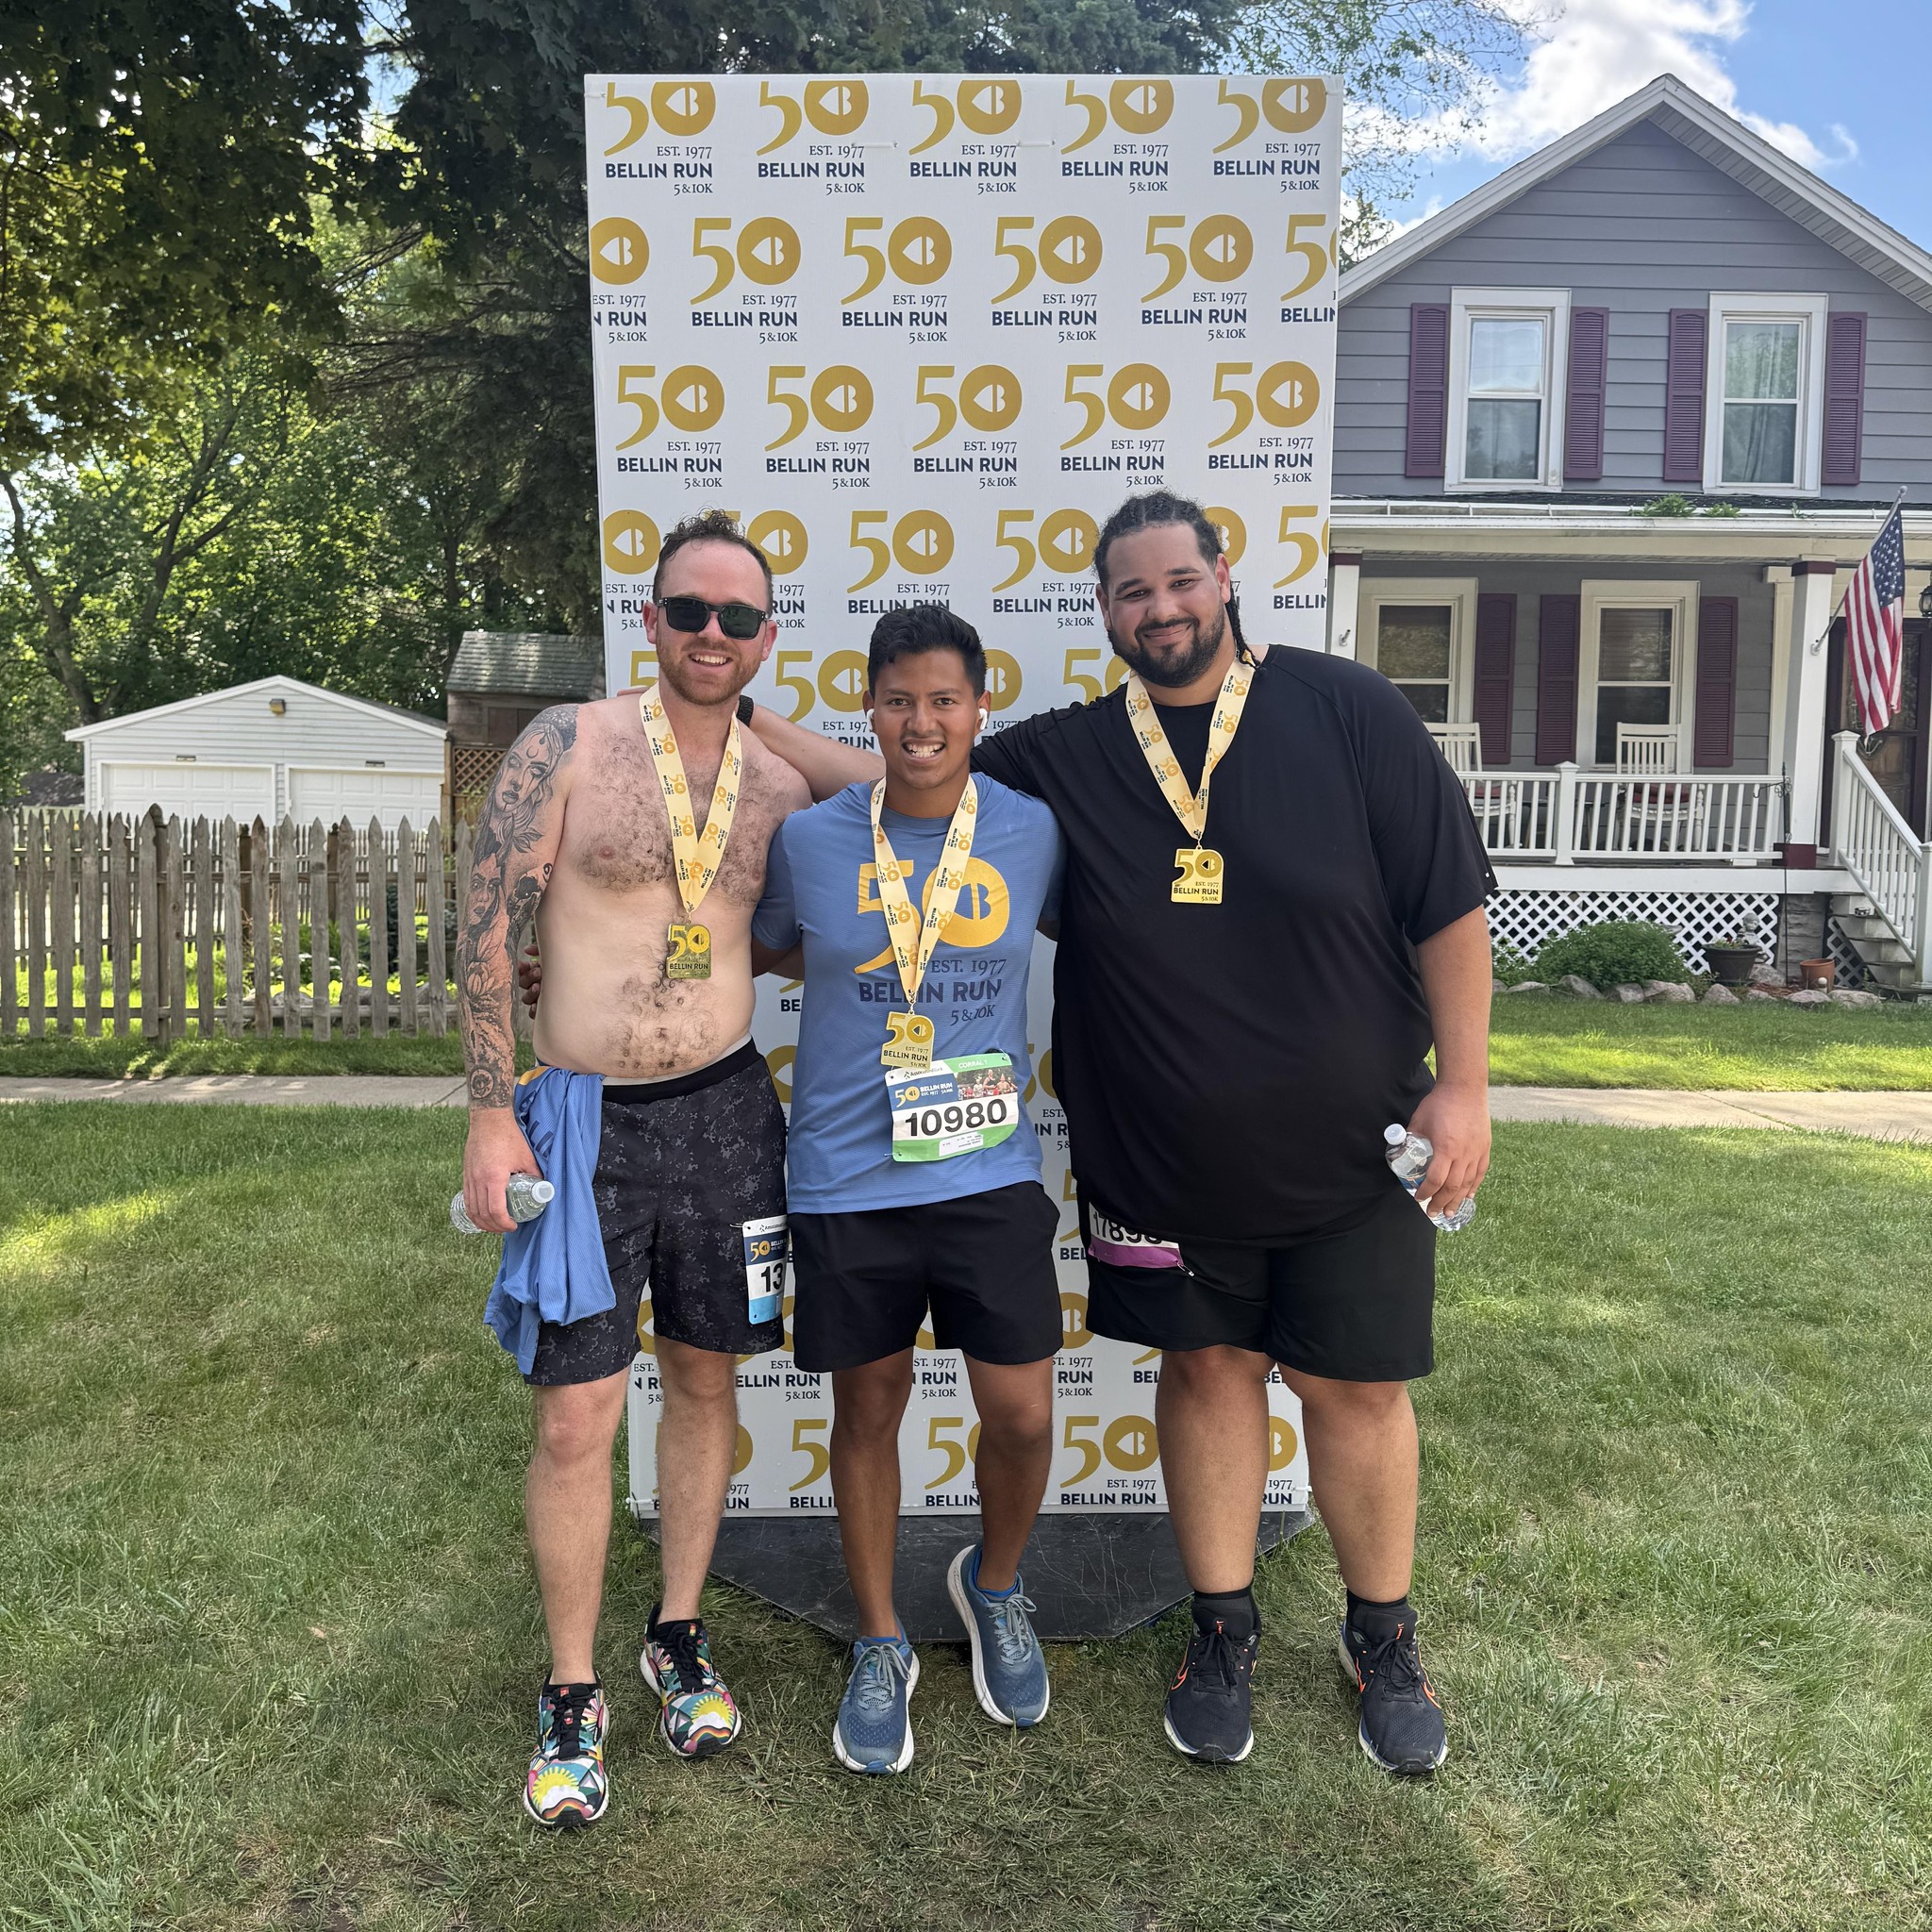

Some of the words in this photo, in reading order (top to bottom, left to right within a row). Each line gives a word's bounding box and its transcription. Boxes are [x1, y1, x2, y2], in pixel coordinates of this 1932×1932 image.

[604, 81, 716, 157] 50
[756, 81, 868, 157] 50
[908, 80, 1021, 156] 50
[1060, 79, 1173, 155] 50
[1212, 78, 1324, 154] 50
[658, 146, 680, 156] EST.
[686, 147, 712, 158] 1977
[809, 145, 833, 156] EST.
[839, 145, 864, 158] 1977
[961, 145, 985, 155] EST.
[991, 145, 1017, 158] 1977
[1114, 144, 1137, 154] EST.
[1142, 144, 1169, 157] 1977
[1266, 143, 1289, 153] EST.
[1294, 143, 1321, 156] 1977
[606, 163, 667, 178] BELLIN
[674, 163, 712, 177] RUN
[758, 162, 819, 177] BELLIN
[826, 162, 864, 177] RUN
[910, 161, 971, 176] BELLIN
[978, 161, 1016, 176] RUN
[1062, 161, 1123, 176] BELLIN
[1130, 161, 1168, 175] RUN
[1214, 160, 1274, 175] BELLIN
[1281, 159, 1320, 175] RUN
[675, 183, 713, 196] 5&10K
[826, 183, 865, 195] 5&10K
[978, 182, 1017, 195] 5&10K
[1129, 181, 1168, 194] 5&10K
[1280, 180, 1320, 192] 5&10K
[691, 218, 801, 305] 50
[841, 218, 951, 305] 50
[991, 216, 1101, 304] 50
[1140, 215, 1251, 302] 50
[620, 295, 646, 308] 1977
[742, 295, 766, 305] EST.
[772, 295, 797, 308] 1977
[893, 295, 916, 305] EST.
[922, 295, 947, 308] 1977
[1043, 294, 1066, 304] EST.
[1072, 294, 1097, 307] 1977
[1193, 292, 1216, 302] EST.
[1222, 292, 1247, 305] 1977
[608, 311, 647, 326] RUN
[692, 311, 753, 326] BELLIN
[759, 312, 797, 326] RUN
[842, 311, 903, 326] BELLIN
[909, 311, 947, 326] RUN
[992, 310, 1052, 325] BELLIN
[1059, 310, 1096, 325] RUN
[1141, 309, 1202, 325] BELLIN
[1208, 308, 1246, 324] RUN
[608, 332, 647, 344] 5&10K
[759, 332, 798, 344] 5&10K
[909, 332, 947, 344] 5&10K
[1058, 331, 1096, 343] 5&10K
[1208, 328, 1246, 341] 5&10K
[616, 364, 725, 451] 50
[764, 364, 874, 451] 50
[912, 364, 1022, 450] 50
[1059, 362, 1169, 449] 50
[1207, 360, 1316, 447] 50
[668, 441, 691, 451] EST.
[696, 442, 721, 454] 1977
[816, 442, 839, 451] EST.
[844, 442, 870, 455] 1977
[964, 441, 986, 451] EST.
[991, 441, 1017, 454] 1977
[1111, 440, 1134, 449] EST.
[1140, 440, 1165, 452] 1977
[1259, 438, 1282, 447] EST.
[1288, 438, 1313, 449] 1977
[617, 458, 677, 473] BELLIN
[684, 458, 722, 473] RUN
[766, 458, 825, 473] BELLIN
[832, 458, 870, 473] RUN
[914, 458, 973, 472] BELLIN
[980, 458, 1017, 472] RUN
[1061, 457, 1120, 471] BELLIN
[1127, 456, 1164, 470] RUN
[1208, 454, 1268, 469] BELLIN
[1274, 453, 1312, 468] RUN
[685, 478, 723, 490] 5&10K
[833, 478, 870, 490] 5&10K
[979, 477, 1017, 490] 5&10K
[1126, 475, 1165, 489] 5&10K
[1274, 473, 1311, 485] 5&10K
[847, 509, 955, 593] 50
[779, 585, 805, 596] 1977
[897, 584, 920, 593] EST.
[924, 585, 950, 596] 1977
[1042, 582, 1064, 592] EST.
[1070, 583, 1095, 594] 1977
[993, 599, 1052, 613] BELLIN
[1058, 598, 1094, 612] RUN
[1058, 617, 1094, 628] 5&10K
[1174, 850, 1223, 884] 50
[668, 924, 710, 961] 50
[931, 960, 963, 973] EST.
[972, 959, 1007, 975] 1977
[858, 982, 943, 1003] BELIN
[953, 979, 1002, 1002] RUN
[951, 1005, 995, 1026] 5&10K
[885, 1013, 934, 1046] 50
[884, 1050, 909, 1059] BELLIN
[958, 1060, 984, 1069] CORRAL
[906, 1098, 1007, 1136] 10980
[771, 1360, 792, 1370] EST.
[933, 1358, 957, 1369] 1977
[1069, 1357, 1092, 1367] 1977
[786, 1374, 821, 1387] RUN
[922, 1372, 957, 1384] RUN
[1058, 1372, 1092, 1383] RUN
[786, 1391, 821, 1402] 5&10K
[922, 1389, 957, 1399] 5&10K
[1058, 1388, 1092, 1398] 5&10K
[1059, 1415, 1159, 1488] 50
[1107, 1479, 1128, 1488] EST.
[1133, 1480, 1157, 1490] 1977
[1269, 1480, 1292, 1490] 1977
[925, 1495, 980, 1507] BELLIN
[1061, 1493, 1116, 1505] BELLIN
[1122, 1493, 1156, 1504] RUN
